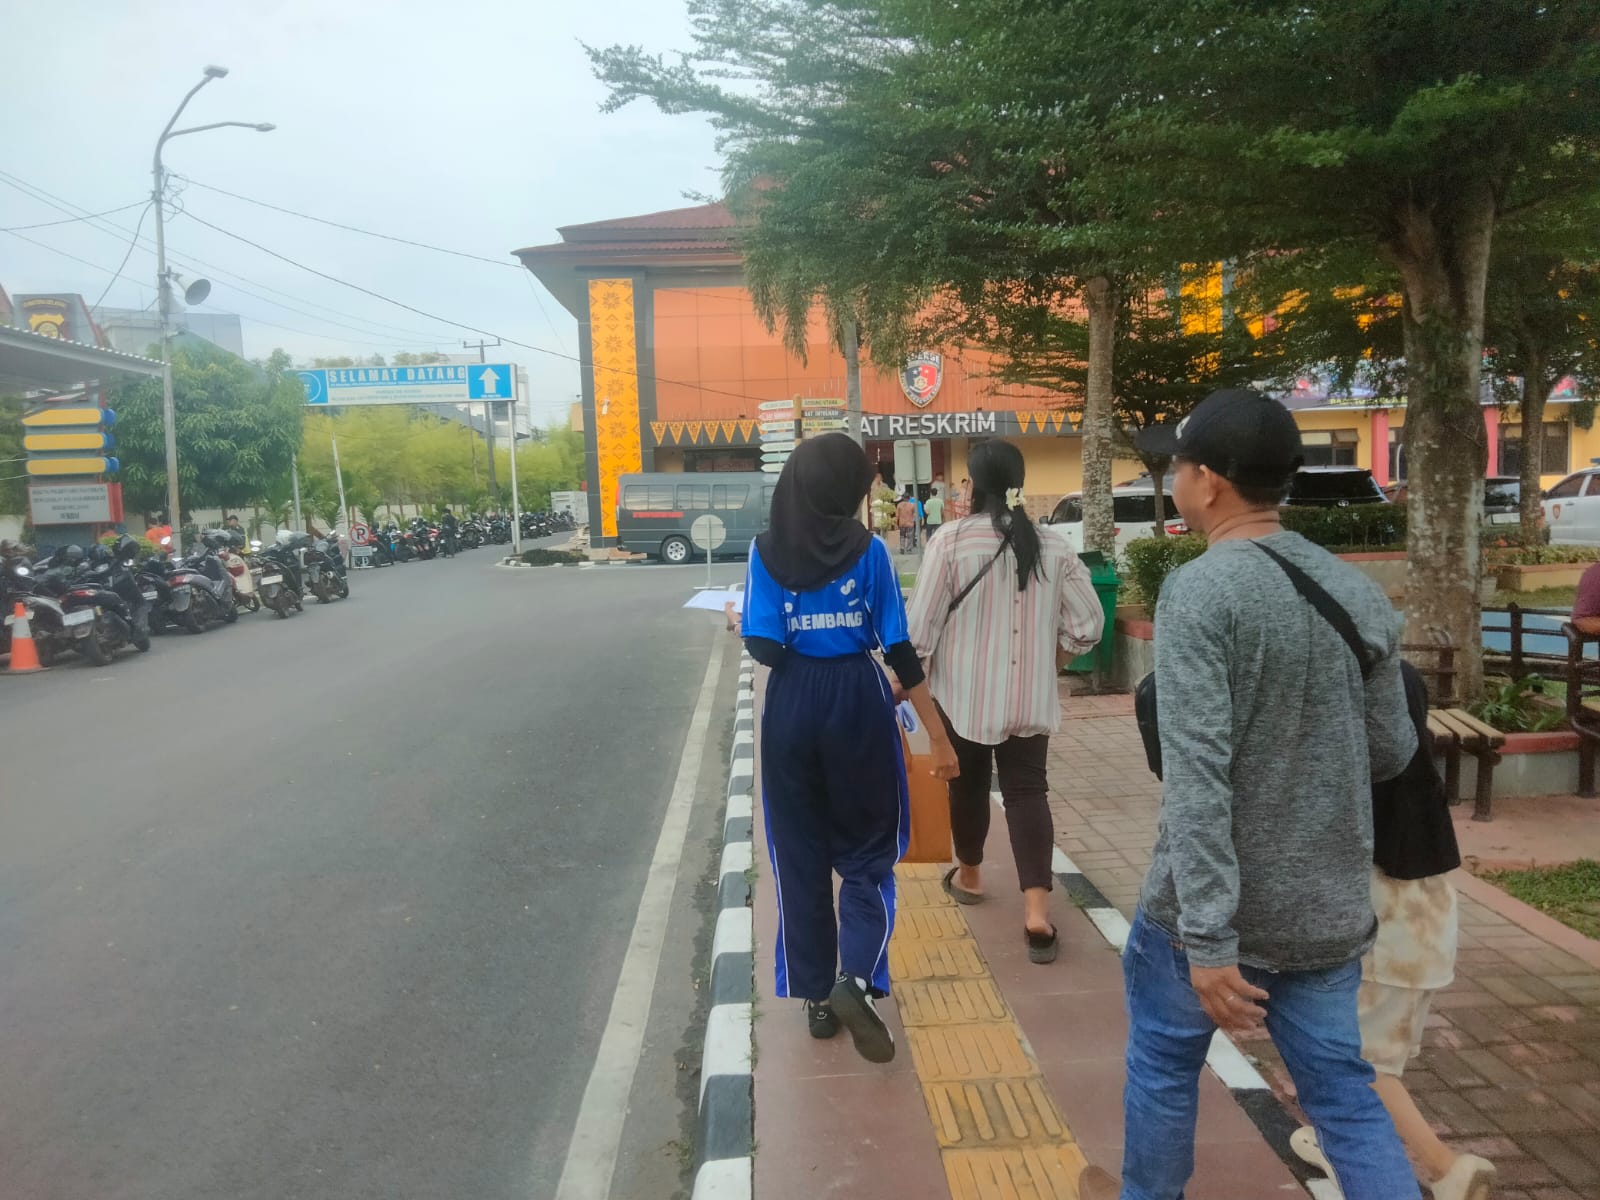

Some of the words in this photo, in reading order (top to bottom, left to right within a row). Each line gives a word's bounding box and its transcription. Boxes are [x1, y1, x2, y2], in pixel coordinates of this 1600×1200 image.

[329, 368, 398, 383] SELAMAT
[407, 367, 466, 380] DATANG
[889, 412, 996, 435] RESKRIM
